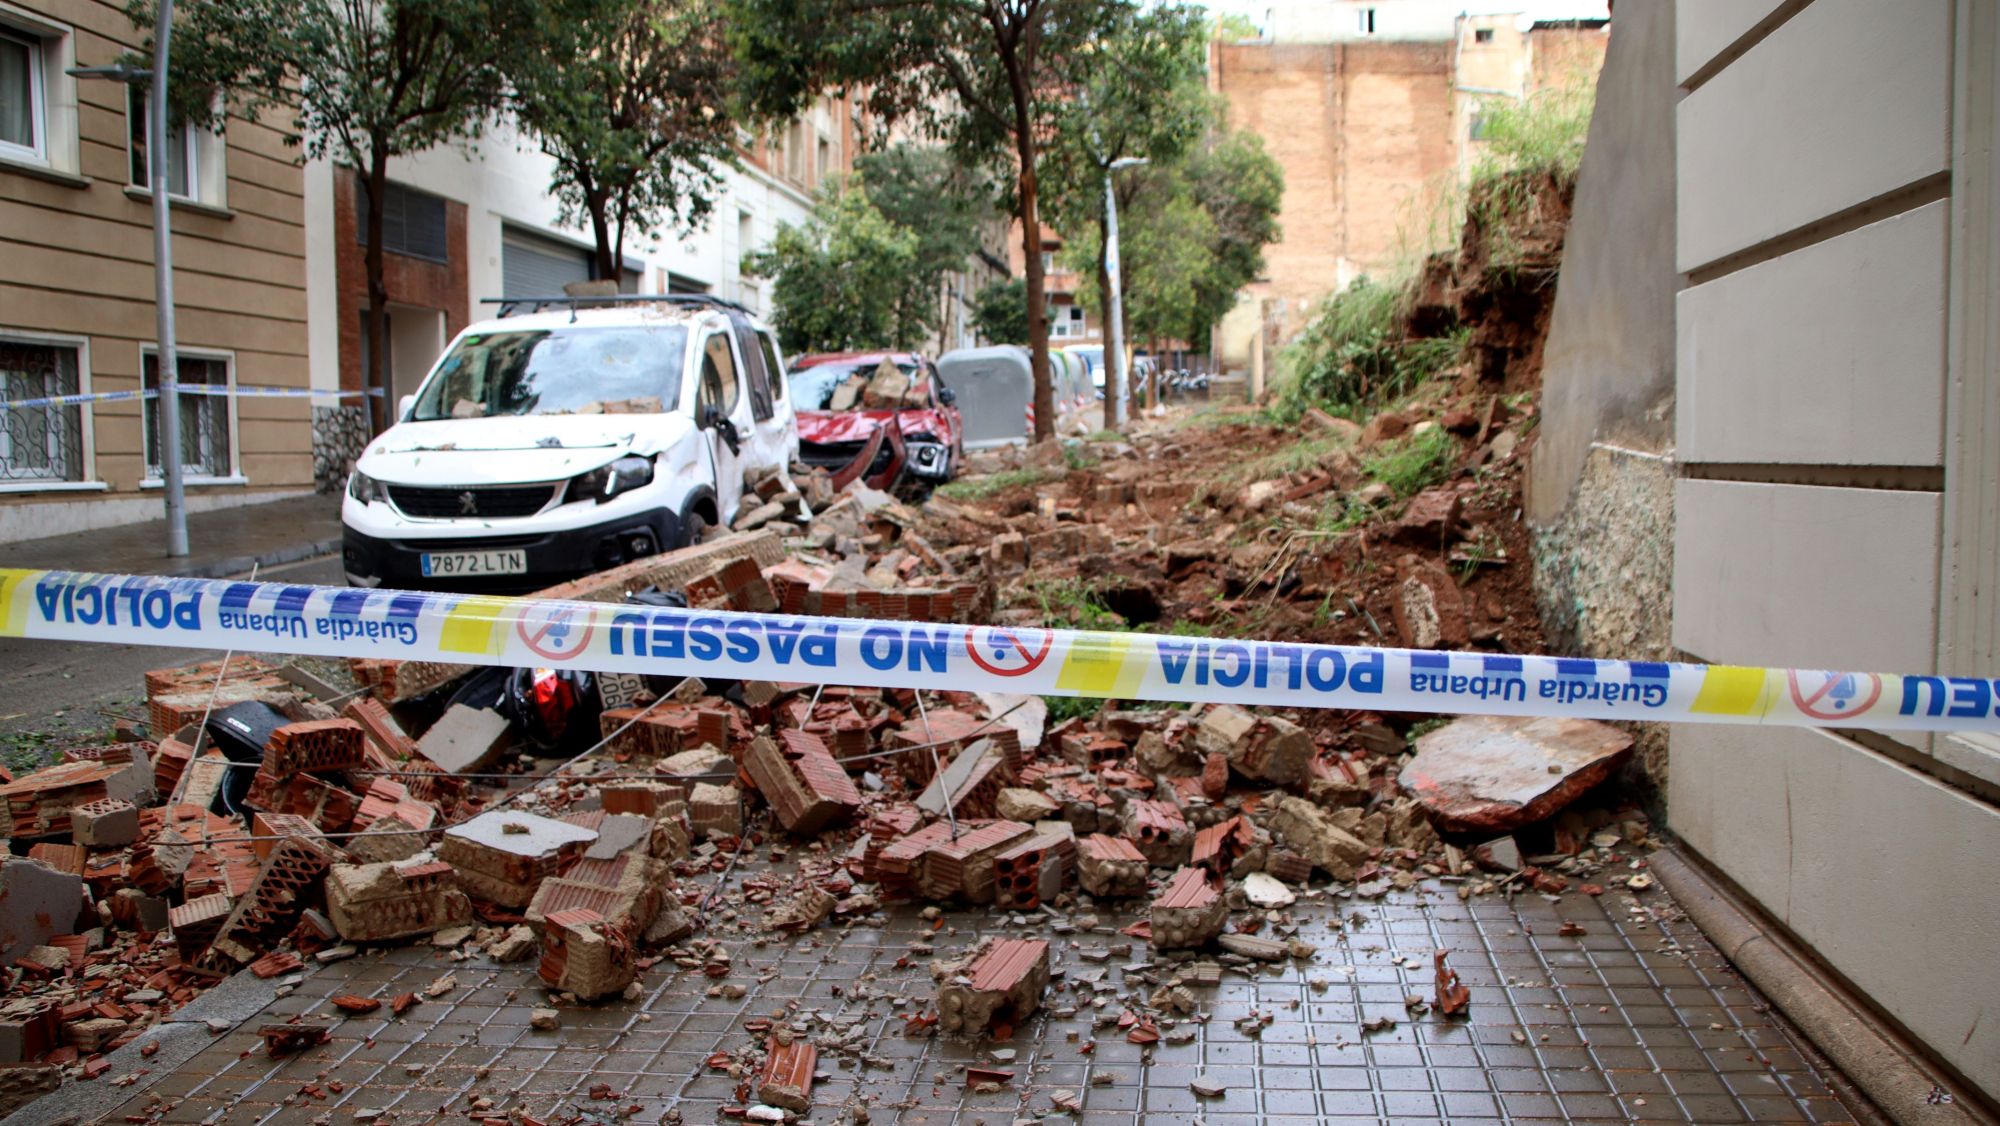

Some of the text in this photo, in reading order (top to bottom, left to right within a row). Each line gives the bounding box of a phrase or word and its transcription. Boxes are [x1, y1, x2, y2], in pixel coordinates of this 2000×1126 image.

[431, 552, 521, 573] 7872 LTN
[36, 583, 204, 630] POLICIA
[219, 612, 418, 645] Guàrdia Urbana
[609, 613, 949, 673] NO PASSEU
[1155, 641, 1384, 694] POLICIA
[1409, 672, 1668, 707] Guàrdia Urbana
